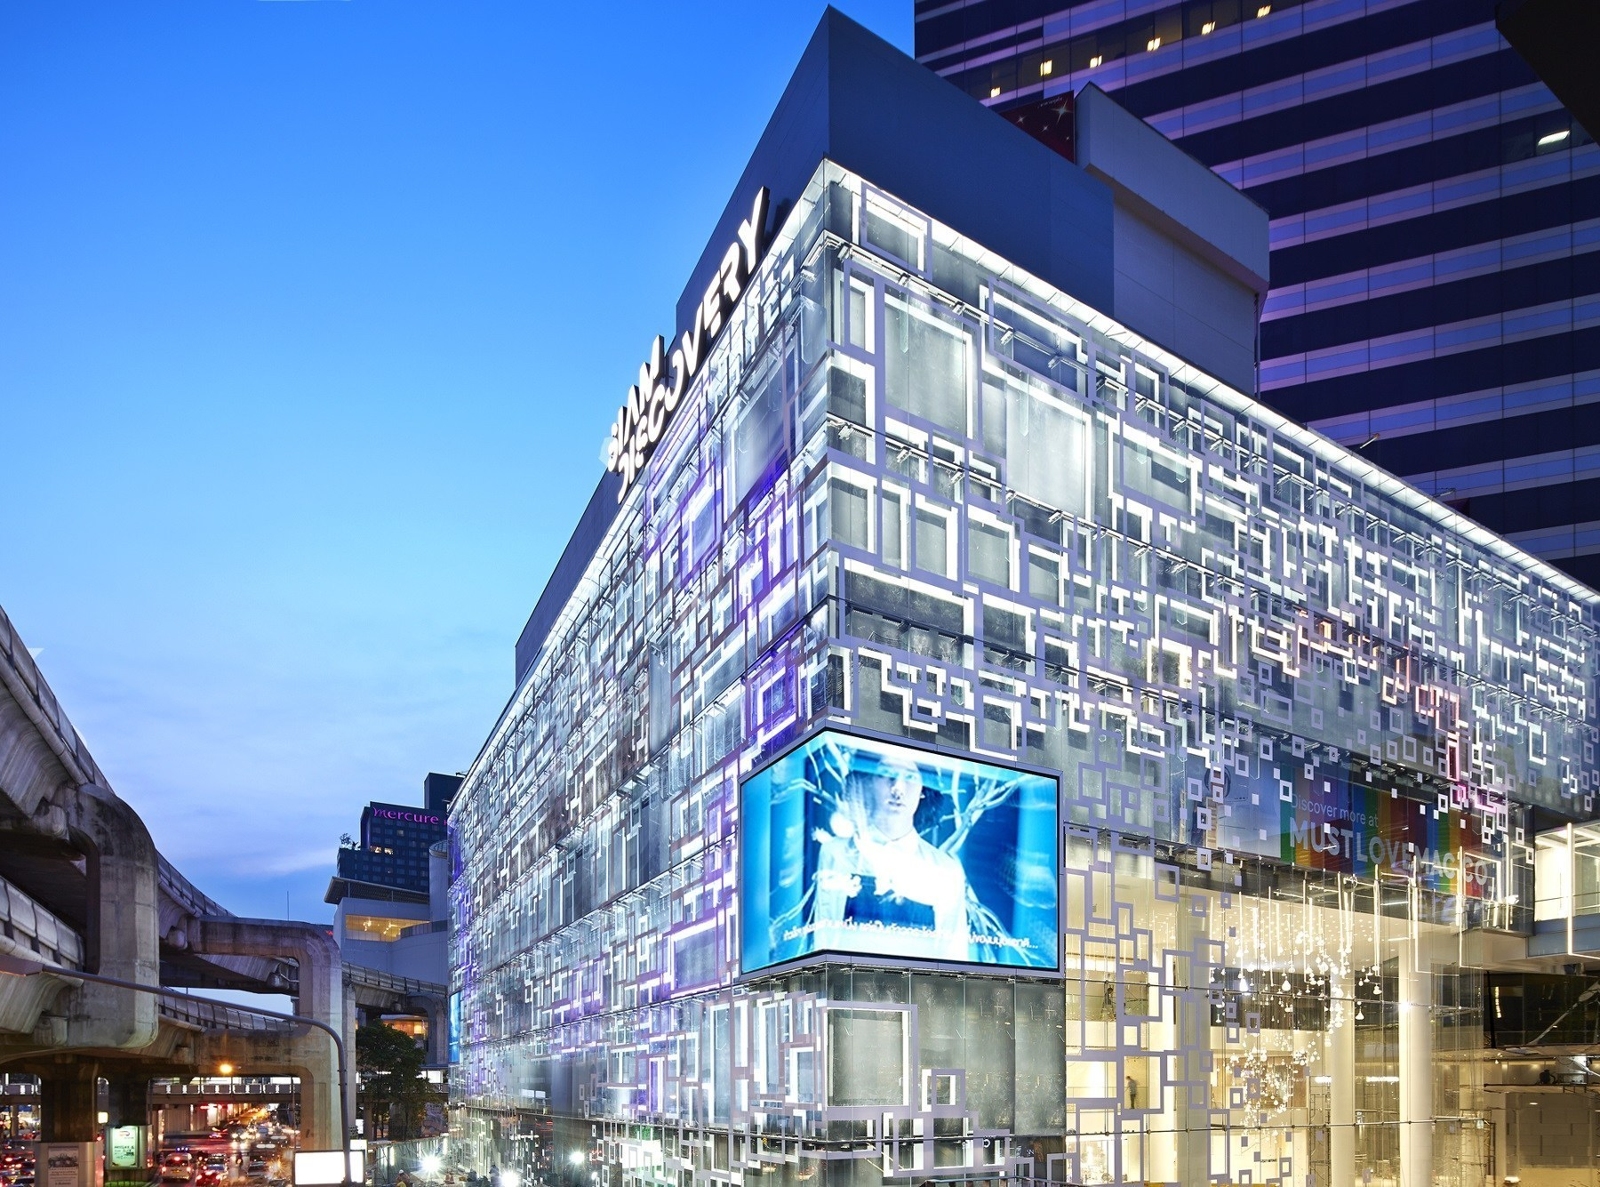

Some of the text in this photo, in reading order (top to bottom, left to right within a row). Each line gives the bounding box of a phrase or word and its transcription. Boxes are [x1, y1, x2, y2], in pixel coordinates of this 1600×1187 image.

[607, 335, 664, 473] SIAM
[617, 186, 769, 505] DISCOVERY
[1290, 794, 1379, 828] Discover more at
